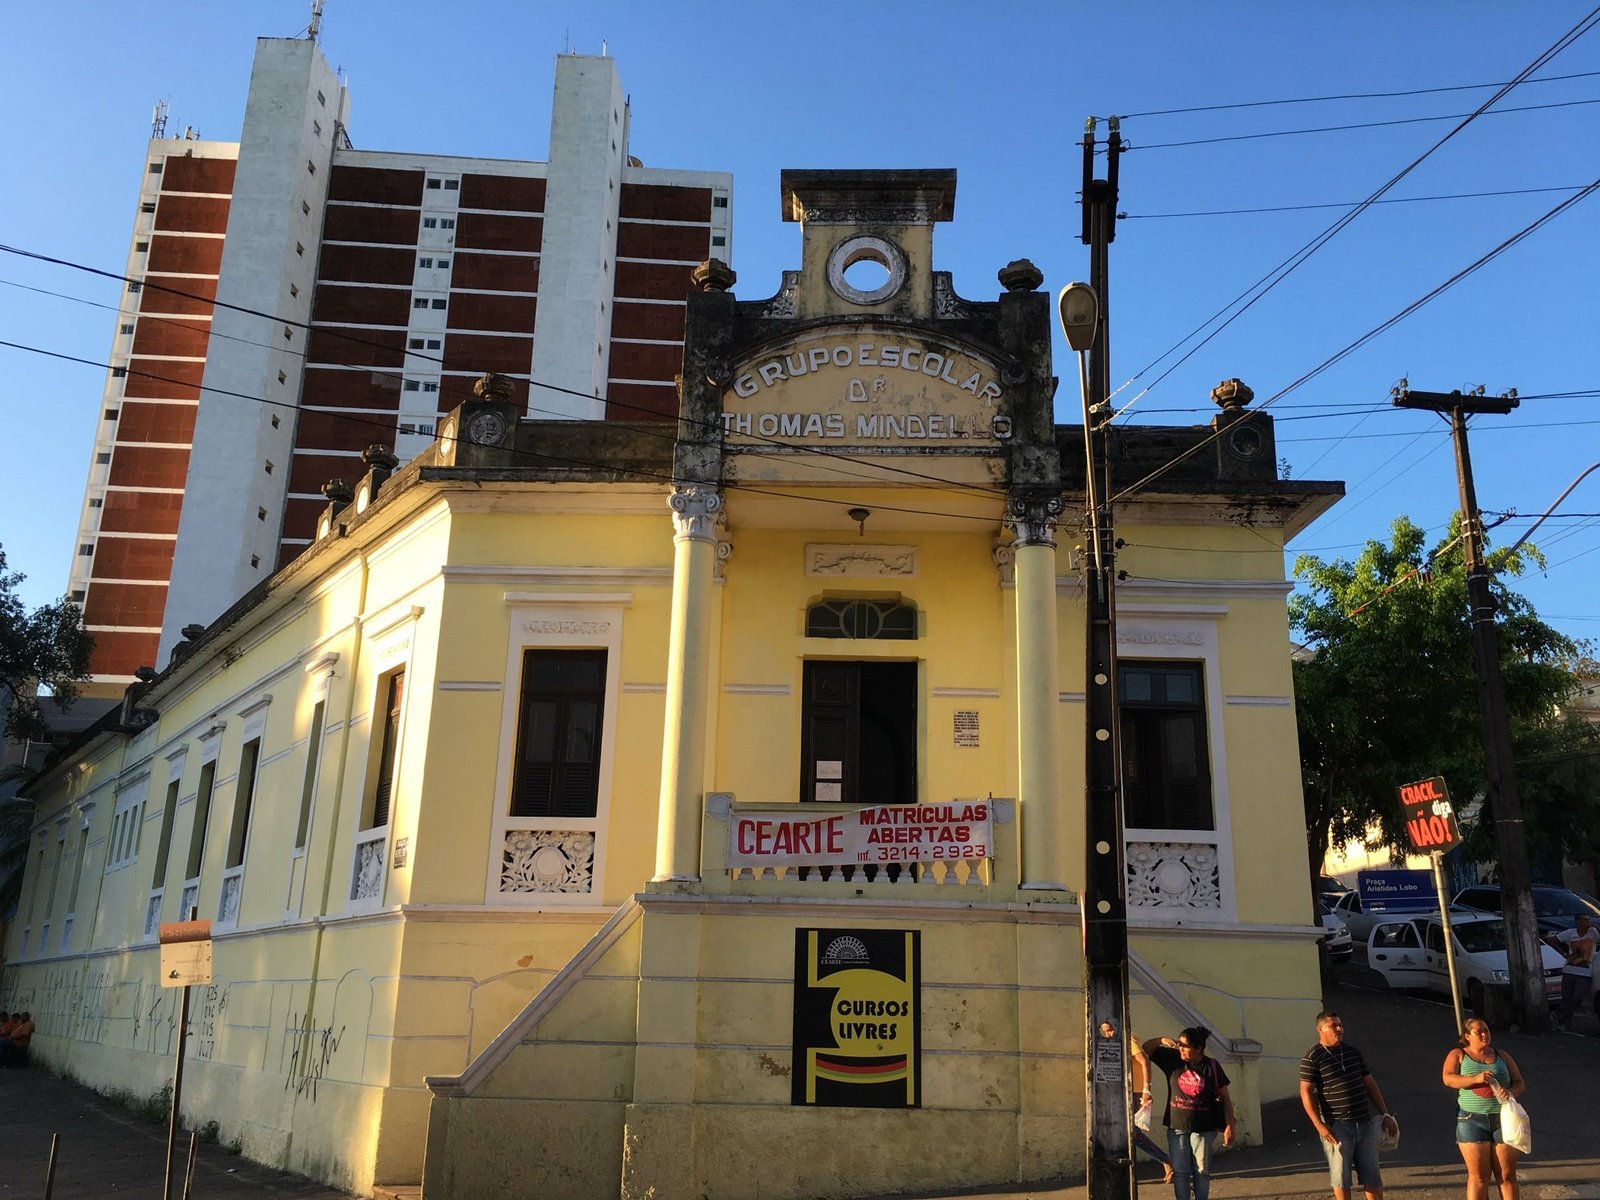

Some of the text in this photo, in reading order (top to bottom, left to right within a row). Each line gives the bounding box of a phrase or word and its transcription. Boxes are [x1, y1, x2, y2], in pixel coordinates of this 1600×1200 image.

[733, 344, 1003, 407] GRUPO ESCOLAR
[721, 412, 1013, 439] THOMAS MINDELLO
[859, 803, 988, 826] MATRÍCULAS
[1432, 799, 1452, 819] diga
[737, 815, 844, 855] CEARTE
[867, 825, 971, 844] ABERTAS
[1407, 809, 1453, 847] NÃO!
[1365, 878, 1386, 886] Praça
[837, 1000, 909, 1017] CURSOS
[838, 1022, 897, 1040] LIVRES
